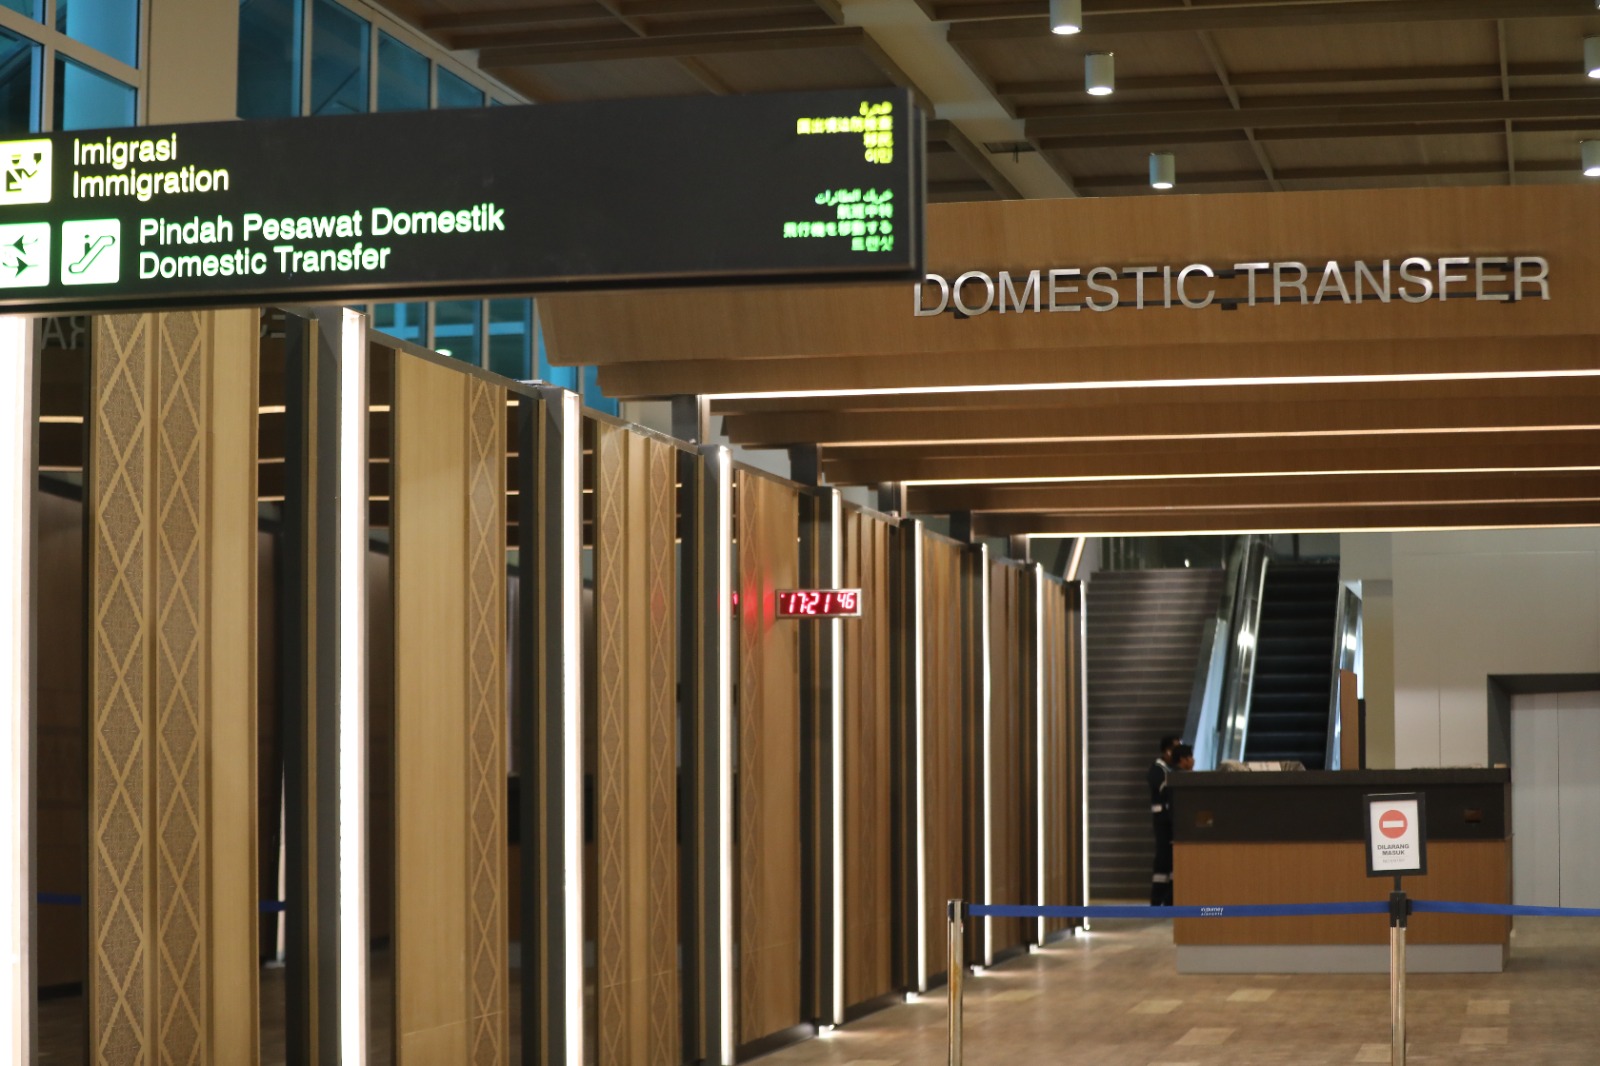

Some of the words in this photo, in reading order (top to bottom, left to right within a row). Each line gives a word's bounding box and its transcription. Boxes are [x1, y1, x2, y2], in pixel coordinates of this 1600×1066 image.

[72, 132, 178, 170] Imigrasi
[72, 165, 230, 202] Immigration
[139, 214, 234, 246] Pindah
[243, 209, 363, 241] Pesawat
[371, 203, 506, 236] Domestik
[139, 246, 268, 280] Domestic
[272, 240, 392, 274] Transfer
[914, 264, 1215, 317] DOMESTIC
[1233, 256, 1551, 307] TRANSFER
[837, 593, 854, 609] 46
